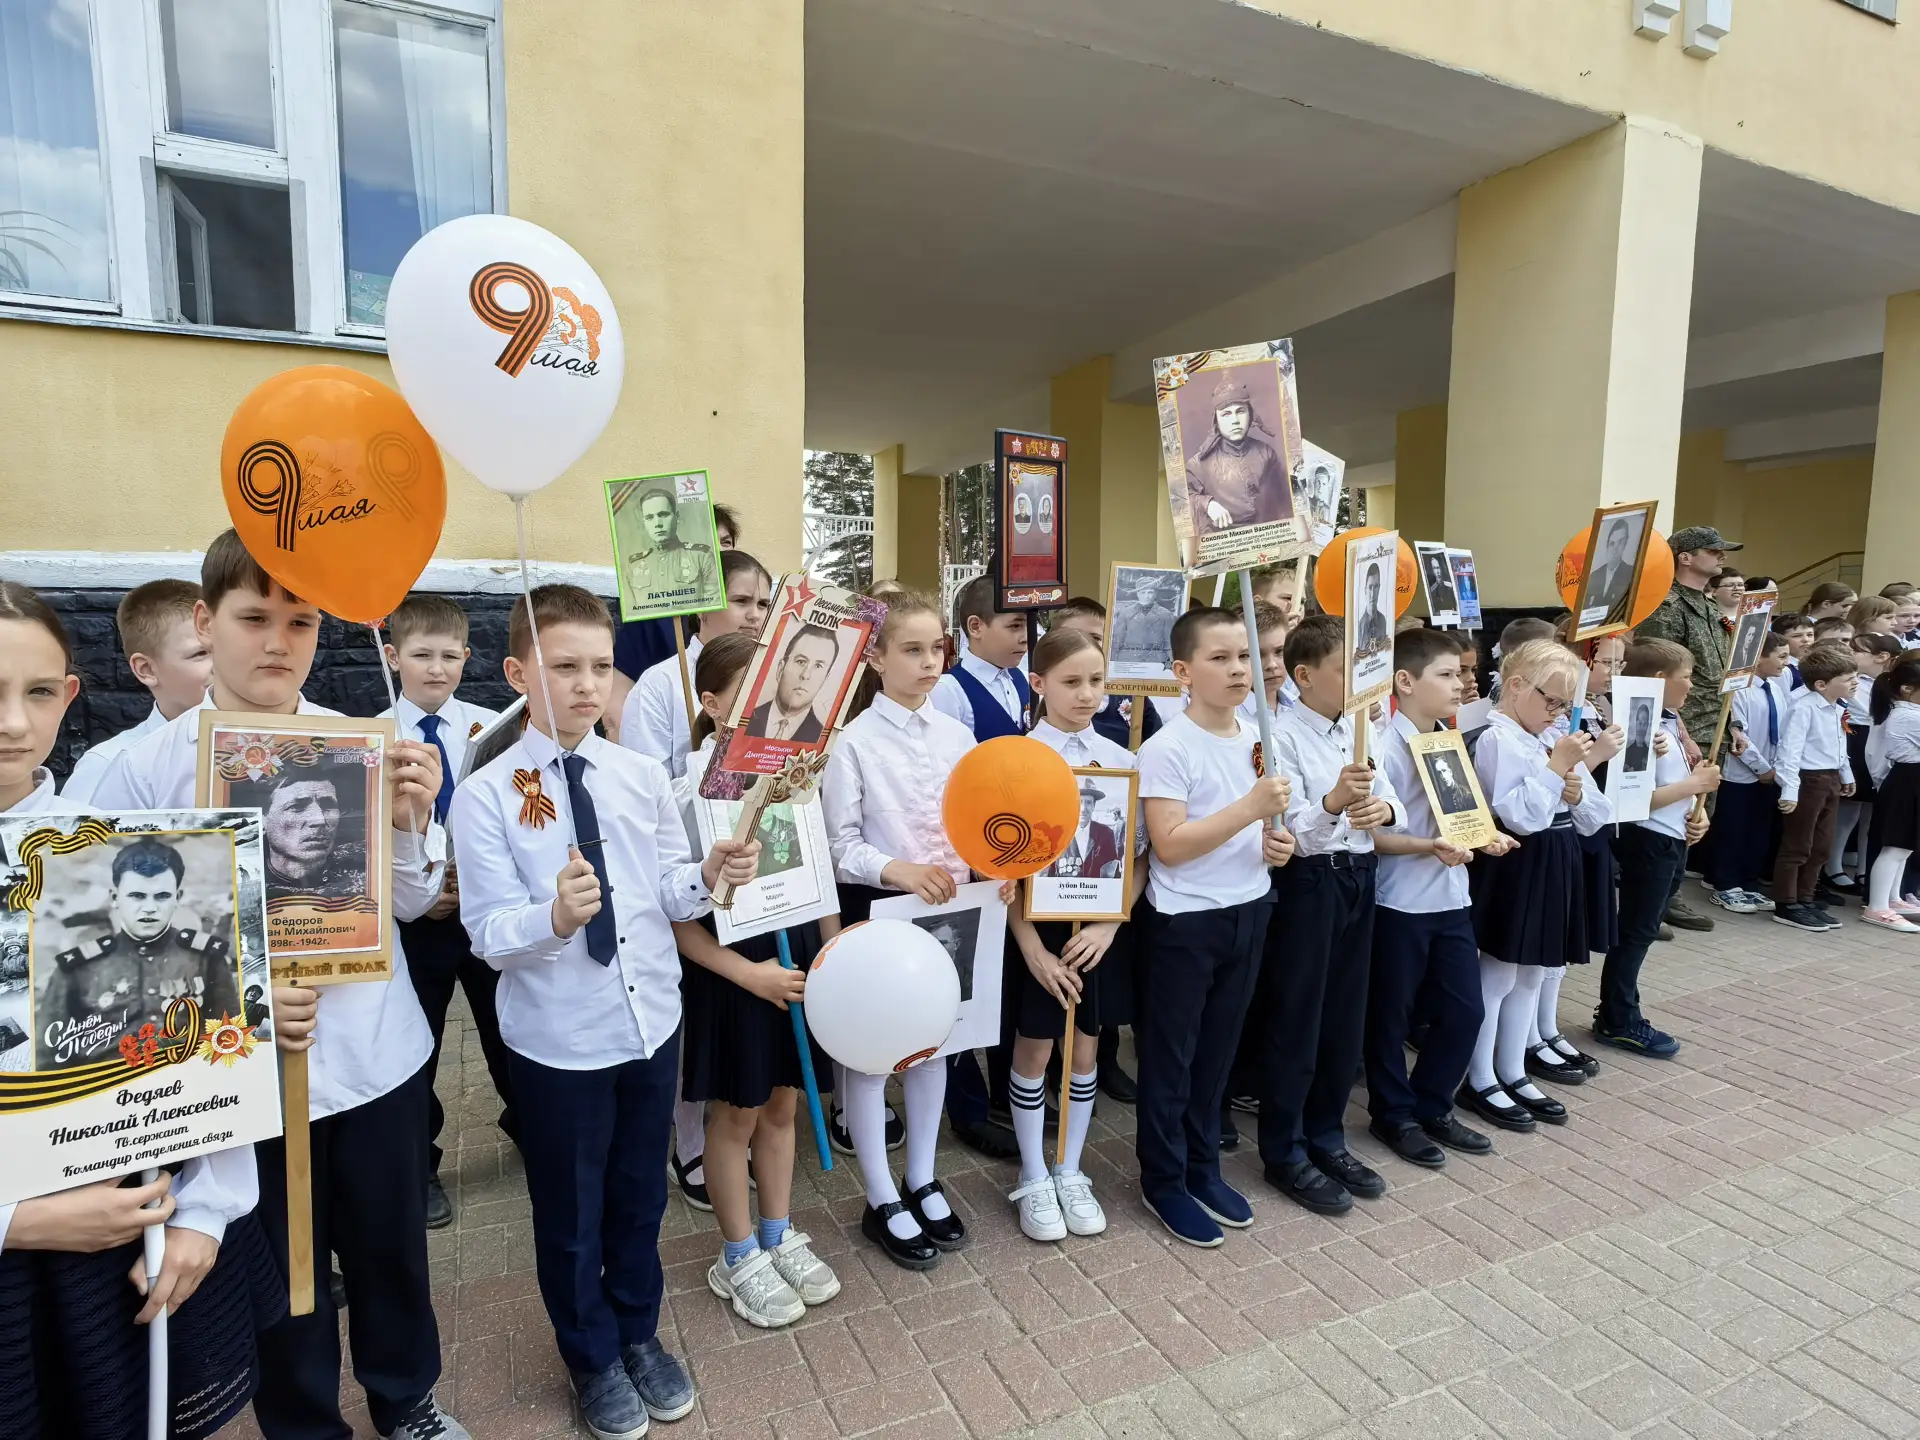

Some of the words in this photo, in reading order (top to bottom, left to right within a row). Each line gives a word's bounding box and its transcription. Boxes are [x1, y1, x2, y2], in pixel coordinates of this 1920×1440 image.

[530, 353, 600, 375] мая
[237, 439, 301, 552] 9
[298, 498, 376, 531] мая
[647, 588, 696, 599] ЛАТЫШЕВ
[632, 603, 670, 611] Александр
[809, 610, 842, 629] ПОЛК
[1159, 685, 1180, 693] ПОЛК
[983, 813, 1031, 867] 9
[272, 917, 323, 927] Фёдоров
[285, 925, 356, 936] Михайлович
[269, 937, 330, 948] 898г.-1942г.
[339, 961, 387, 975] ПОЛК
[115, 1079, 184, 1107] Федяев
[49, 1113, 139, 1146] Николай
[142, 1094, 240, 1128] Алексеевич
[62, 1154, 132, 1177] Командир
[135, 1138, 200, 1161] отделения
[202, 1129, 234, 1144] связи
